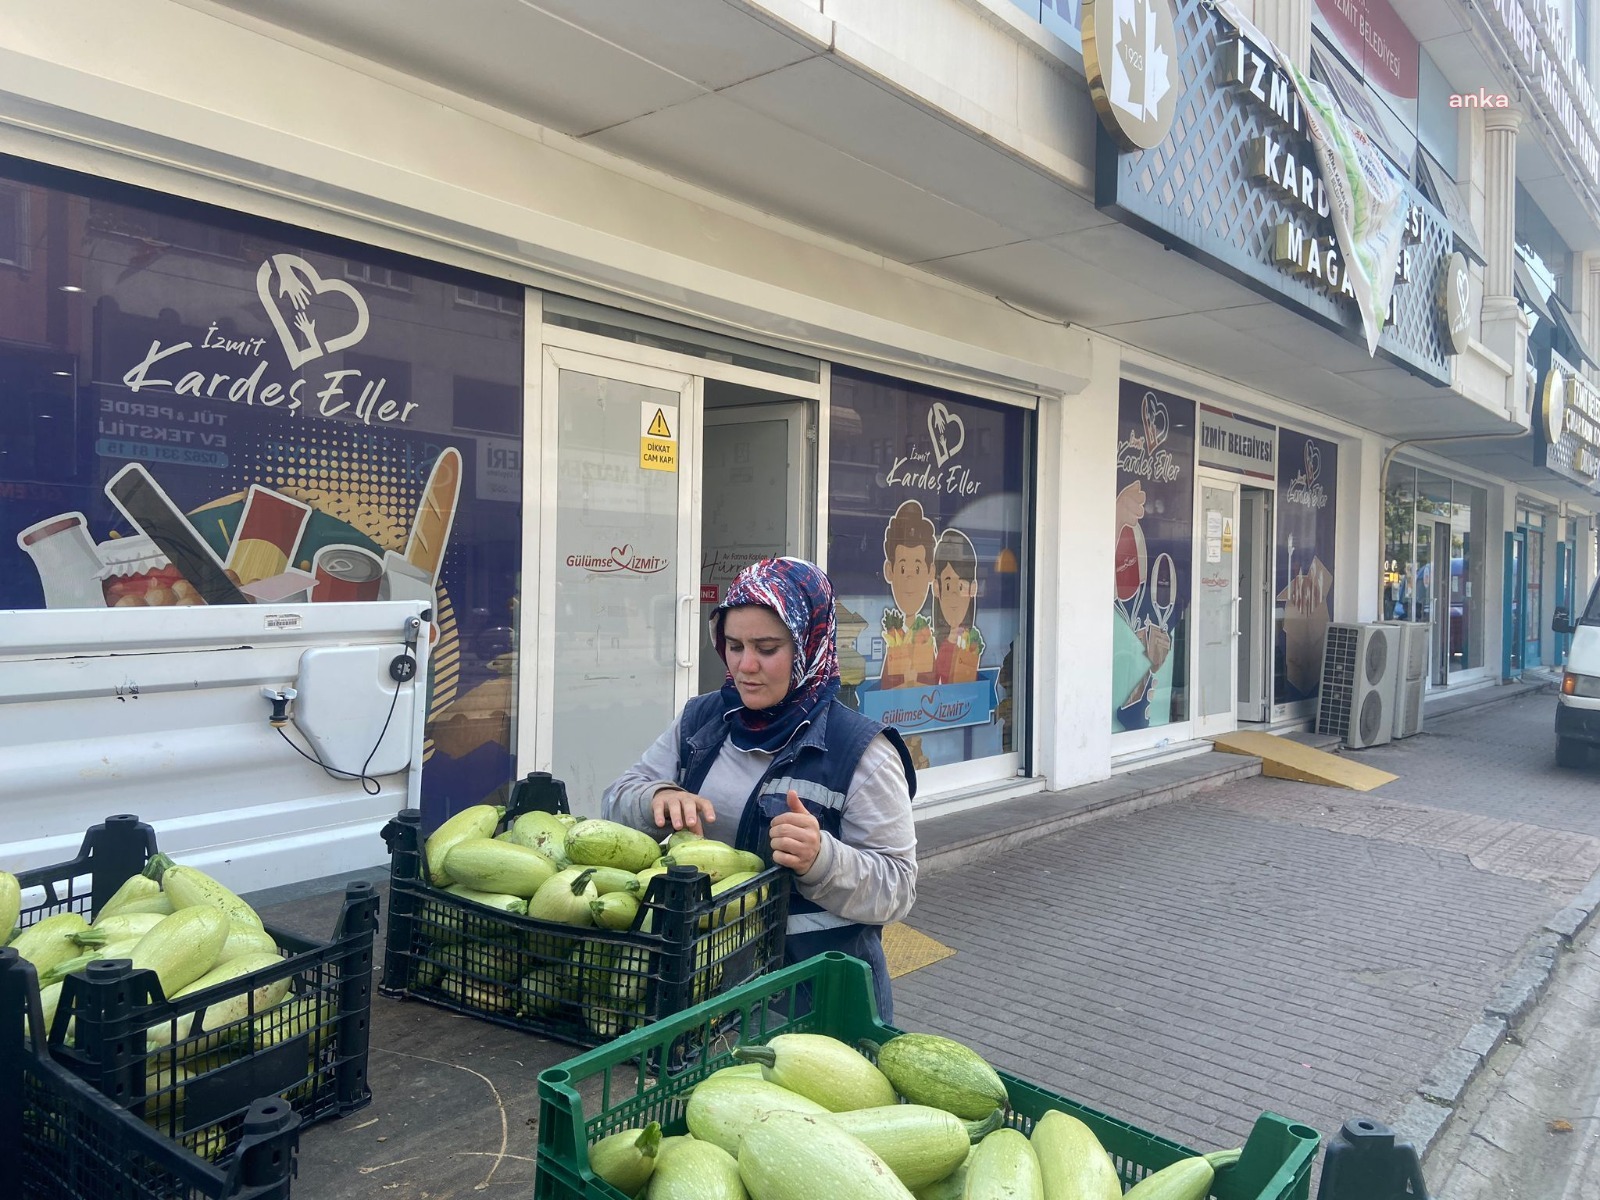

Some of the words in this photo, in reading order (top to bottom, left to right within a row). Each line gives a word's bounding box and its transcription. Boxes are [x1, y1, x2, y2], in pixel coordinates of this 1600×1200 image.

[1124, 44, 1143, 71] 1923
[1360, 15, 1400, 80] BELEDİYESİ
[201, 321, 266, 357] İzmit
[123, 340, 307, 417] Kardeş
[317, 369, 419, 425] Eller
[647, 442, 671, 453] DİKKAT
[909, 444, 931, 462] İzmit
[1201, 421, 1226, 451] İZMİT
[1228, 432, 1273, 462] BELEDİYESİ
[643, 453, 658, 462] CAM
[659, 455, 674, 464] KAPI
[886, 457, 943, 495] Kardeş
[946, 465, 981, 497] Eller
[566, 555, 613, 568] Gülümse
[631, 556, 660, 569] İZMİT
[882, 708, 923, 724] Gülümse
[939, 700, 964, 719] İZMİT
